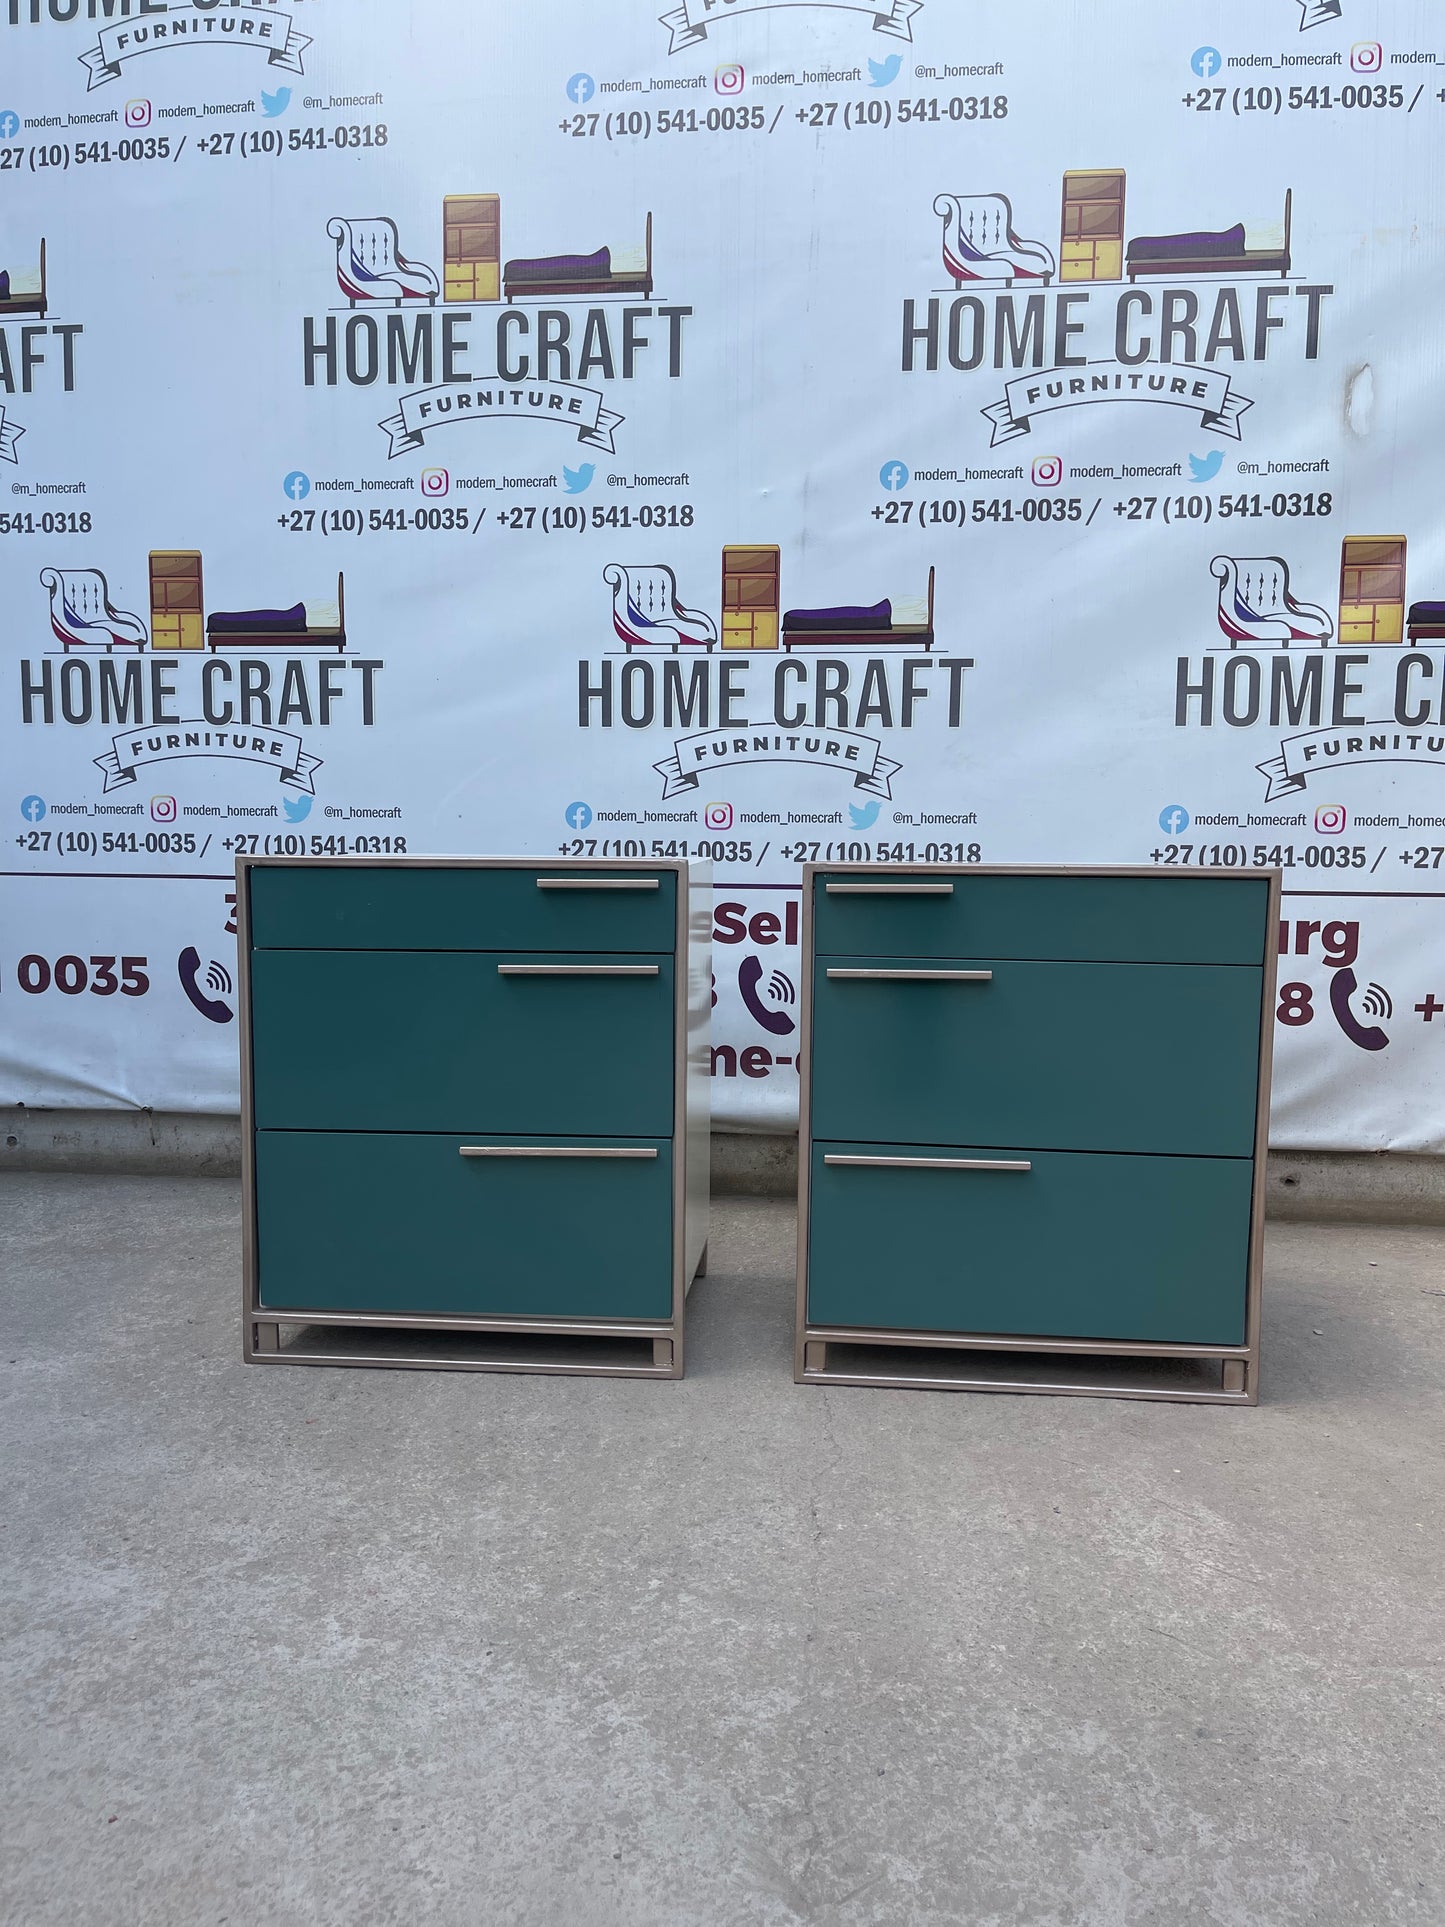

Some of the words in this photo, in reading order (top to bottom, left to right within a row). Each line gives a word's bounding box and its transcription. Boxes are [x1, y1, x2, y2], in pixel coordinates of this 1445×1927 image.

[117, 17, 273, 50] FURNITURE
[1228, 52, 1342, 68] modern_homecraft
[753, 68, 861, 86] modern_homecraft
[915, 62, 1003, 79] @m_homecraft
[599, 75, 707, 94] modern_homecraft
[159, 100, 255, 118] modern_homecraft
[303, 93, 383, 110] @m_homecraft
[1182, 88, 1226, 111] +27
[1233, 87, 1281, 115] (10)
[1288, 85, 1403, 109] 541-0035
[25, 110, 118, 128] modern_homecraft
[559, 114, 599, 137] +27
[606, 111, 651, 137] (10)
[657, 106, 764, 133] 541-0035
[796, 103, 838, 126] +27
[844, 101, 891, 130] (10)
[898, 96, 1008, 122] 541-0318
[30, 145, 69, 172] (10)
[75, 137, 169, 164] 541-0035
[197, 133, 235, 155] +27
[241, 130, 282, 158] (10)
[288, 124, 387, 150] 541-0318
[901, 292, 1090, 371] HOME
[1114, 285, 1334, 365] CRAFT
[303, 312, 473, 386] HOME
[496, 306, 693, 382] CRAFT
[1027, 374, 1208, 404] FURNITURE
[419, 390, 583, 419] FURNITURE
[915, 466, 1023, 482] modern_homecraft
[1070, 463, 1181, 479] modern_homecraft
[1238, 459, 1329, 475] @m_homecraft
[12, 482, 86, 496] @m_homecraft
[316, 478, 414, 492] modern_homecraft
[457, 475, 557, 490] modern_homecraft
[607, 473, 689, 488] @m_homecraft
[278, 510, 315, 531] +27
[321, 510, 363, 536] (10)
[369, 508, 468, 530] 541-0035
[497, 507, 536, 528] +27
[542, 507, 586, 533] (10)
[592, 505, 693, 528] 541-0318
[871, 501, 913, 523] +27
[919, 500, 965, 528] (10)
[972, 499, 1081, 522] 541-0035
[1113, 497, 1157, 519] +27
[1163, 496, 1212, 524] (10)
[1218, 493, 1332, 517] 541-0318
[0, 512, 91, 533] 541-0318
[20, 659, 181, 725] HOME
[201, 658, 384, 726] CRAFT
[578, 660, 750, 728] HOME
[773, 658, 974, 728] CRAFT
[1175, 655, 1369, 726] HOME
[1393, 653, 1445, 726] C
[130, 732, 284, 757] FURNITURE
[694, 736, 860, 761] FURNITURE
[51, 803, 144, 816] modern_homecraft
[184, 805, 278, 818] modern_homecraft
[324, 806, 401, 819] @m_homecraft
[598, 810, 697, 823] modern_homecraft
[741, 812, 842, 825] modern_homecraft
[893, 812, 977, 826] @m_homecraft
[1195, 813, 1306, 827] modern_homecraft
[16, 831, 51, 851] +27
[57, 832, 97, 856] (10)
[103, 833, 195, 853] 541-0035
[223, 834, 259, 854] +27
[265, 835, 305, 855] (10)
[311, 836, 406, 855] 541-0318
[781, 842, 820, 862] +27
[826, 842, 870, 861] (10)
[877, 843, 981, 863] 541-0318
[1150, 845, 1193, 864] +27
[1199, 845, 1246, 866] (10)
[1251, 845, 1366, 870] 541-0035
[1399, 847, 1444, 868] +27
[1278, 921, 1359, 967] rg
[18, 955, 149, 996] 0035
